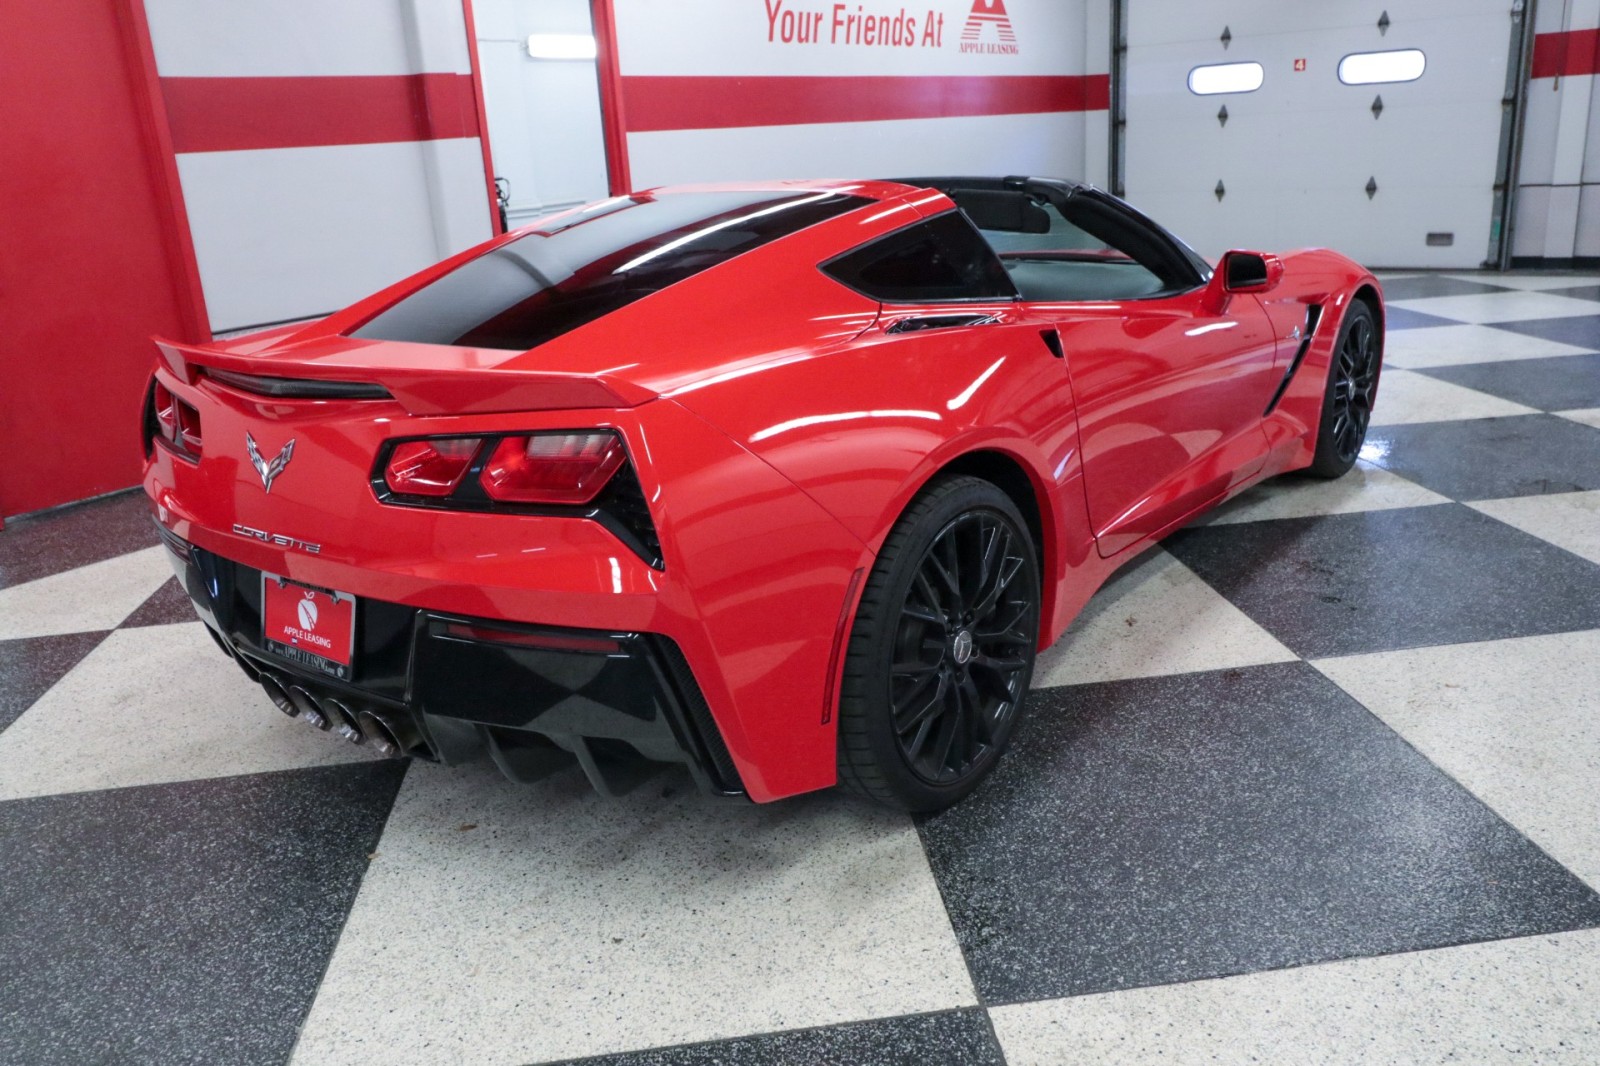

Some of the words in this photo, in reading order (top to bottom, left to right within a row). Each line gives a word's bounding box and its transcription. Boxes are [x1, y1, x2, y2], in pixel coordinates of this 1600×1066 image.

[765, 0, 823, 44] Your
[831, 4, 915, 47] Friends
[922, 10, 944, 47] At
[959, 42, 986, 54] APPLE
[987, 43, 1019, 55] LEASING
[1295, 59, 1304, 71] 4
[233, 523, 321, 554] CORVETTE
[284, 625, 304, 639] APPLE
[304, 632, 331, 648] LEASING
